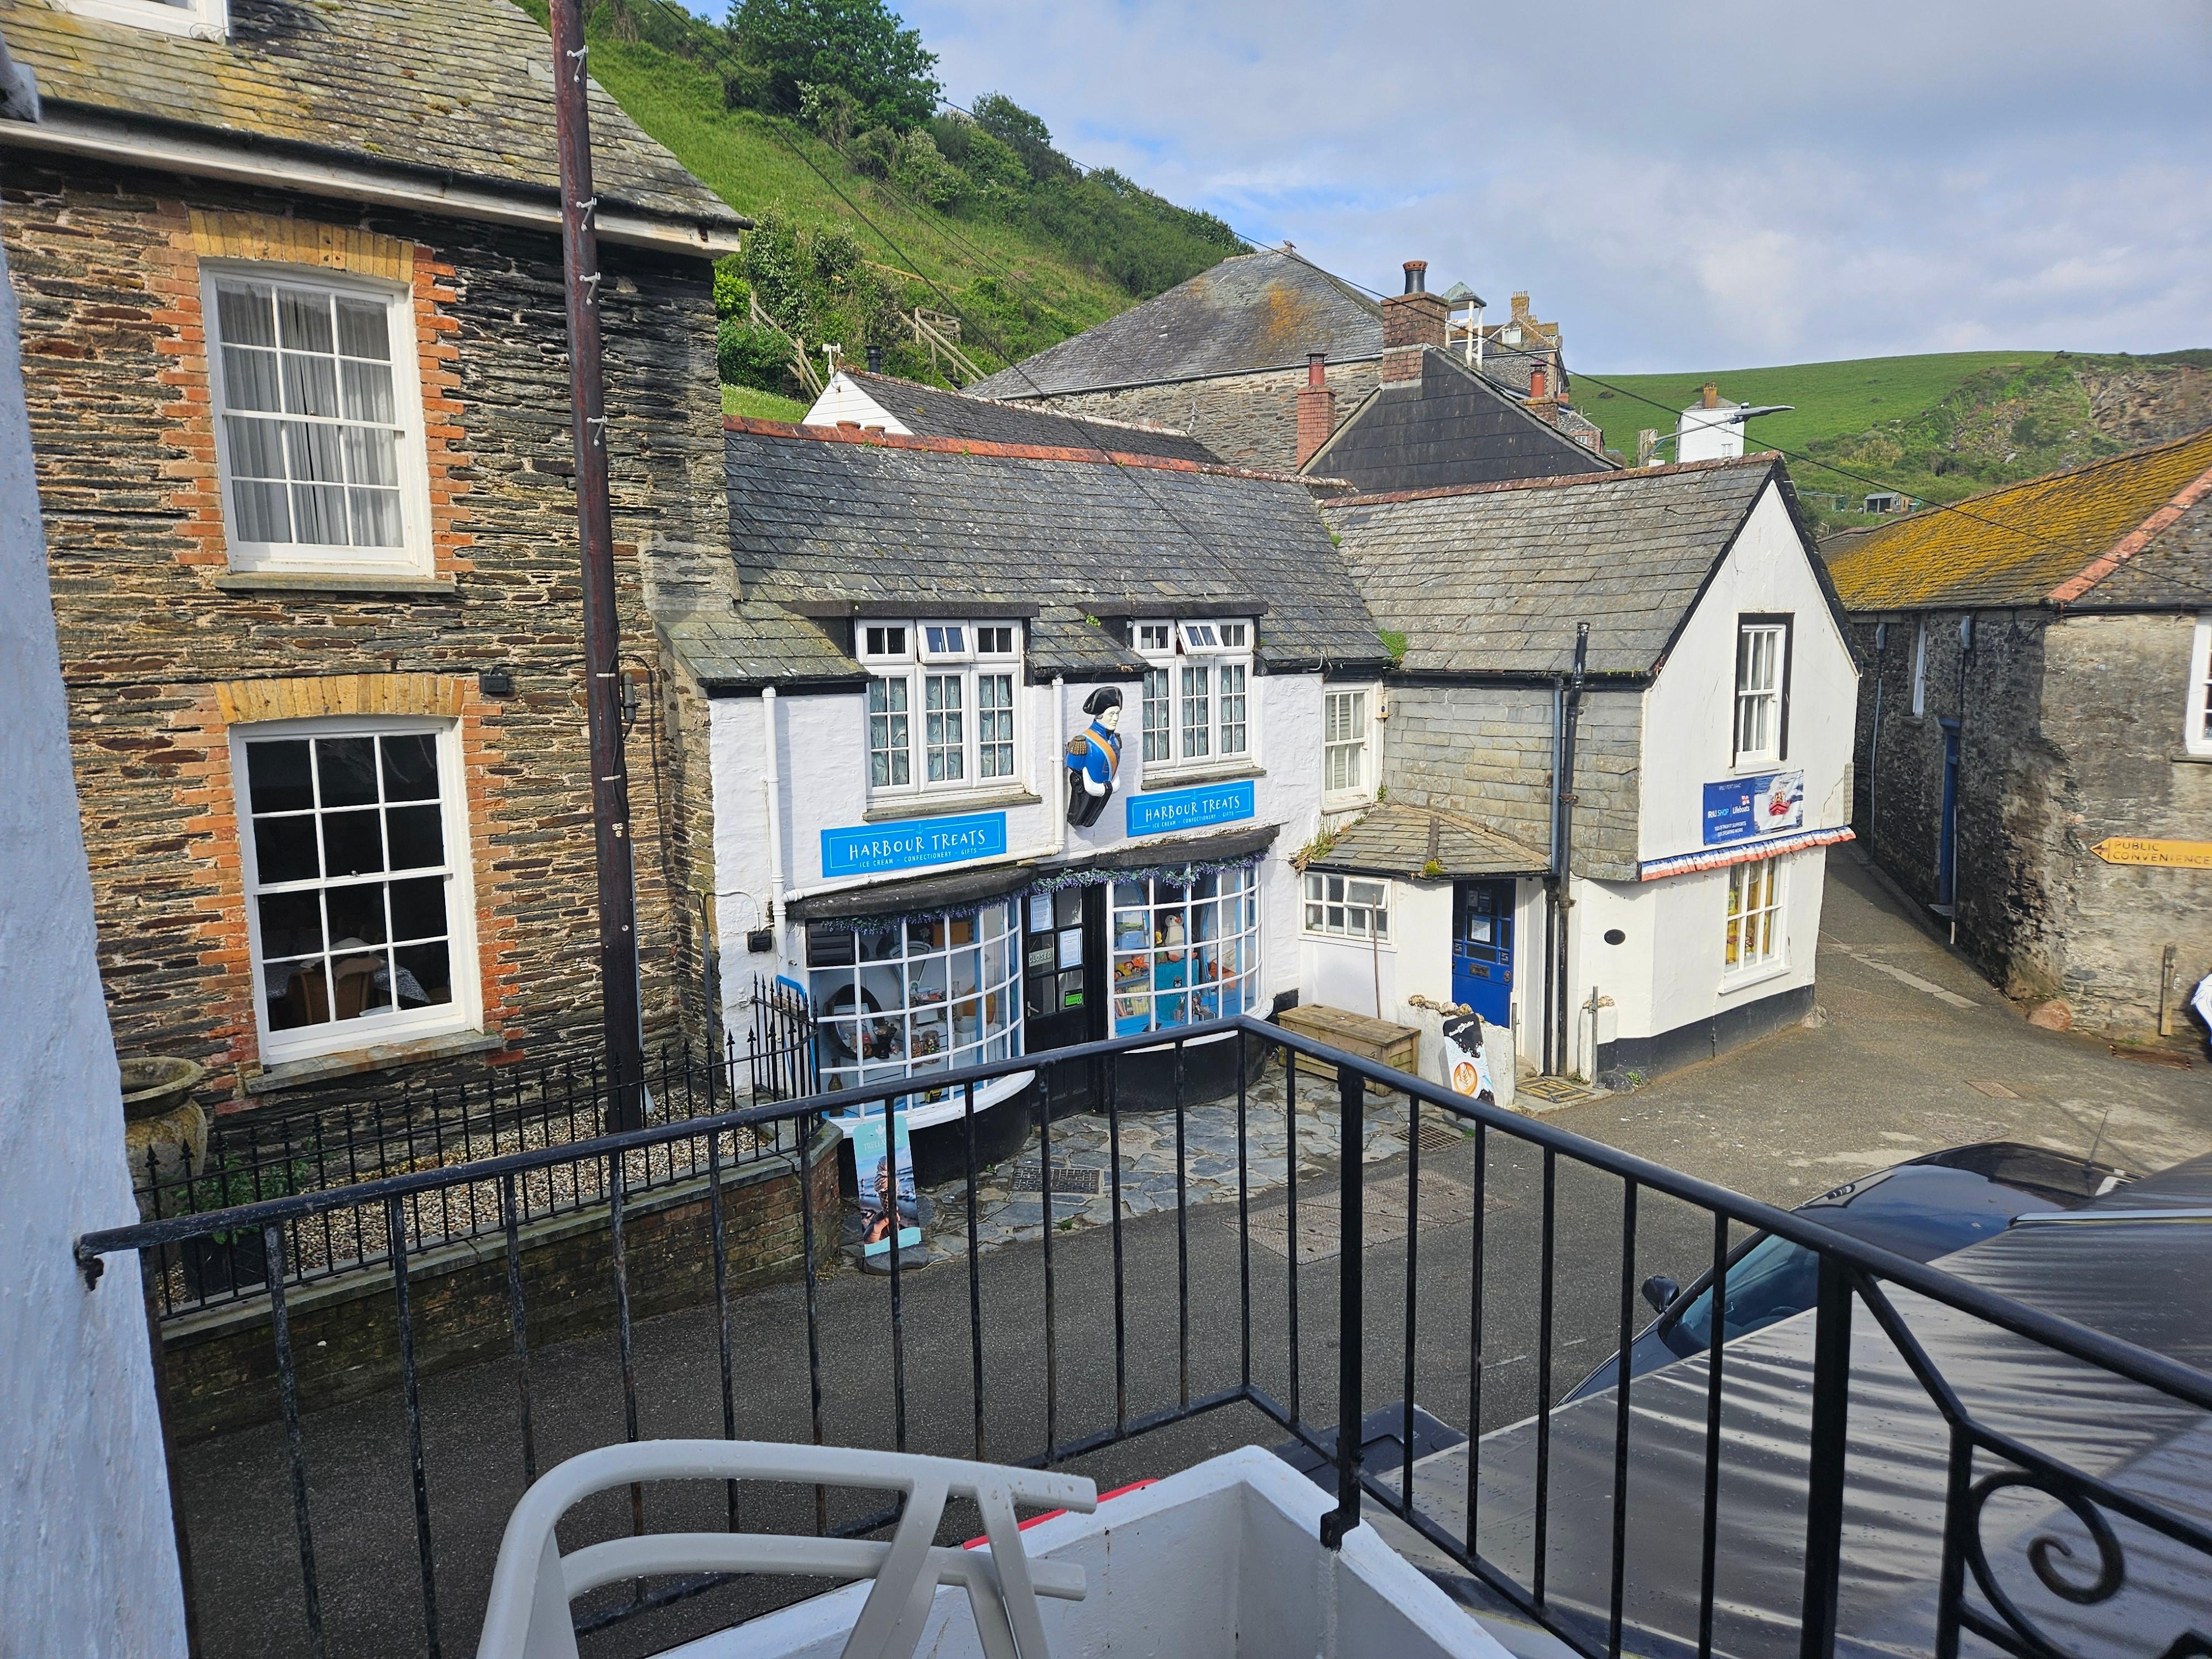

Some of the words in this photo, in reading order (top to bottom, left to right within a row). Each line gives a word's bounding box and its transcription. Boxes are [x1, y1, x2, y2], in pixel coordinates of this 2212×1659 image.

[1146, 802, 1198, 823] HARBOUR
[1202, 795, 1240, 813] TREATS
[1717, 808, 1729, 817] SHOP
[1733, 805, 1750, 814] Lifeboats
[1182, 813, 1216, 824] CONFECTIONERY
[849, 837, 925, 860] HARBOUR
[931, 830, 985, 851] TREATS
[2114, 840, 2159, 852] PUBLIC
[904, 851, 952, 863] CONFECTIONERY
[2113, 851, 2212, 865] CONVENIENCE
[1029, 951, 1052, 964] CLOSED
